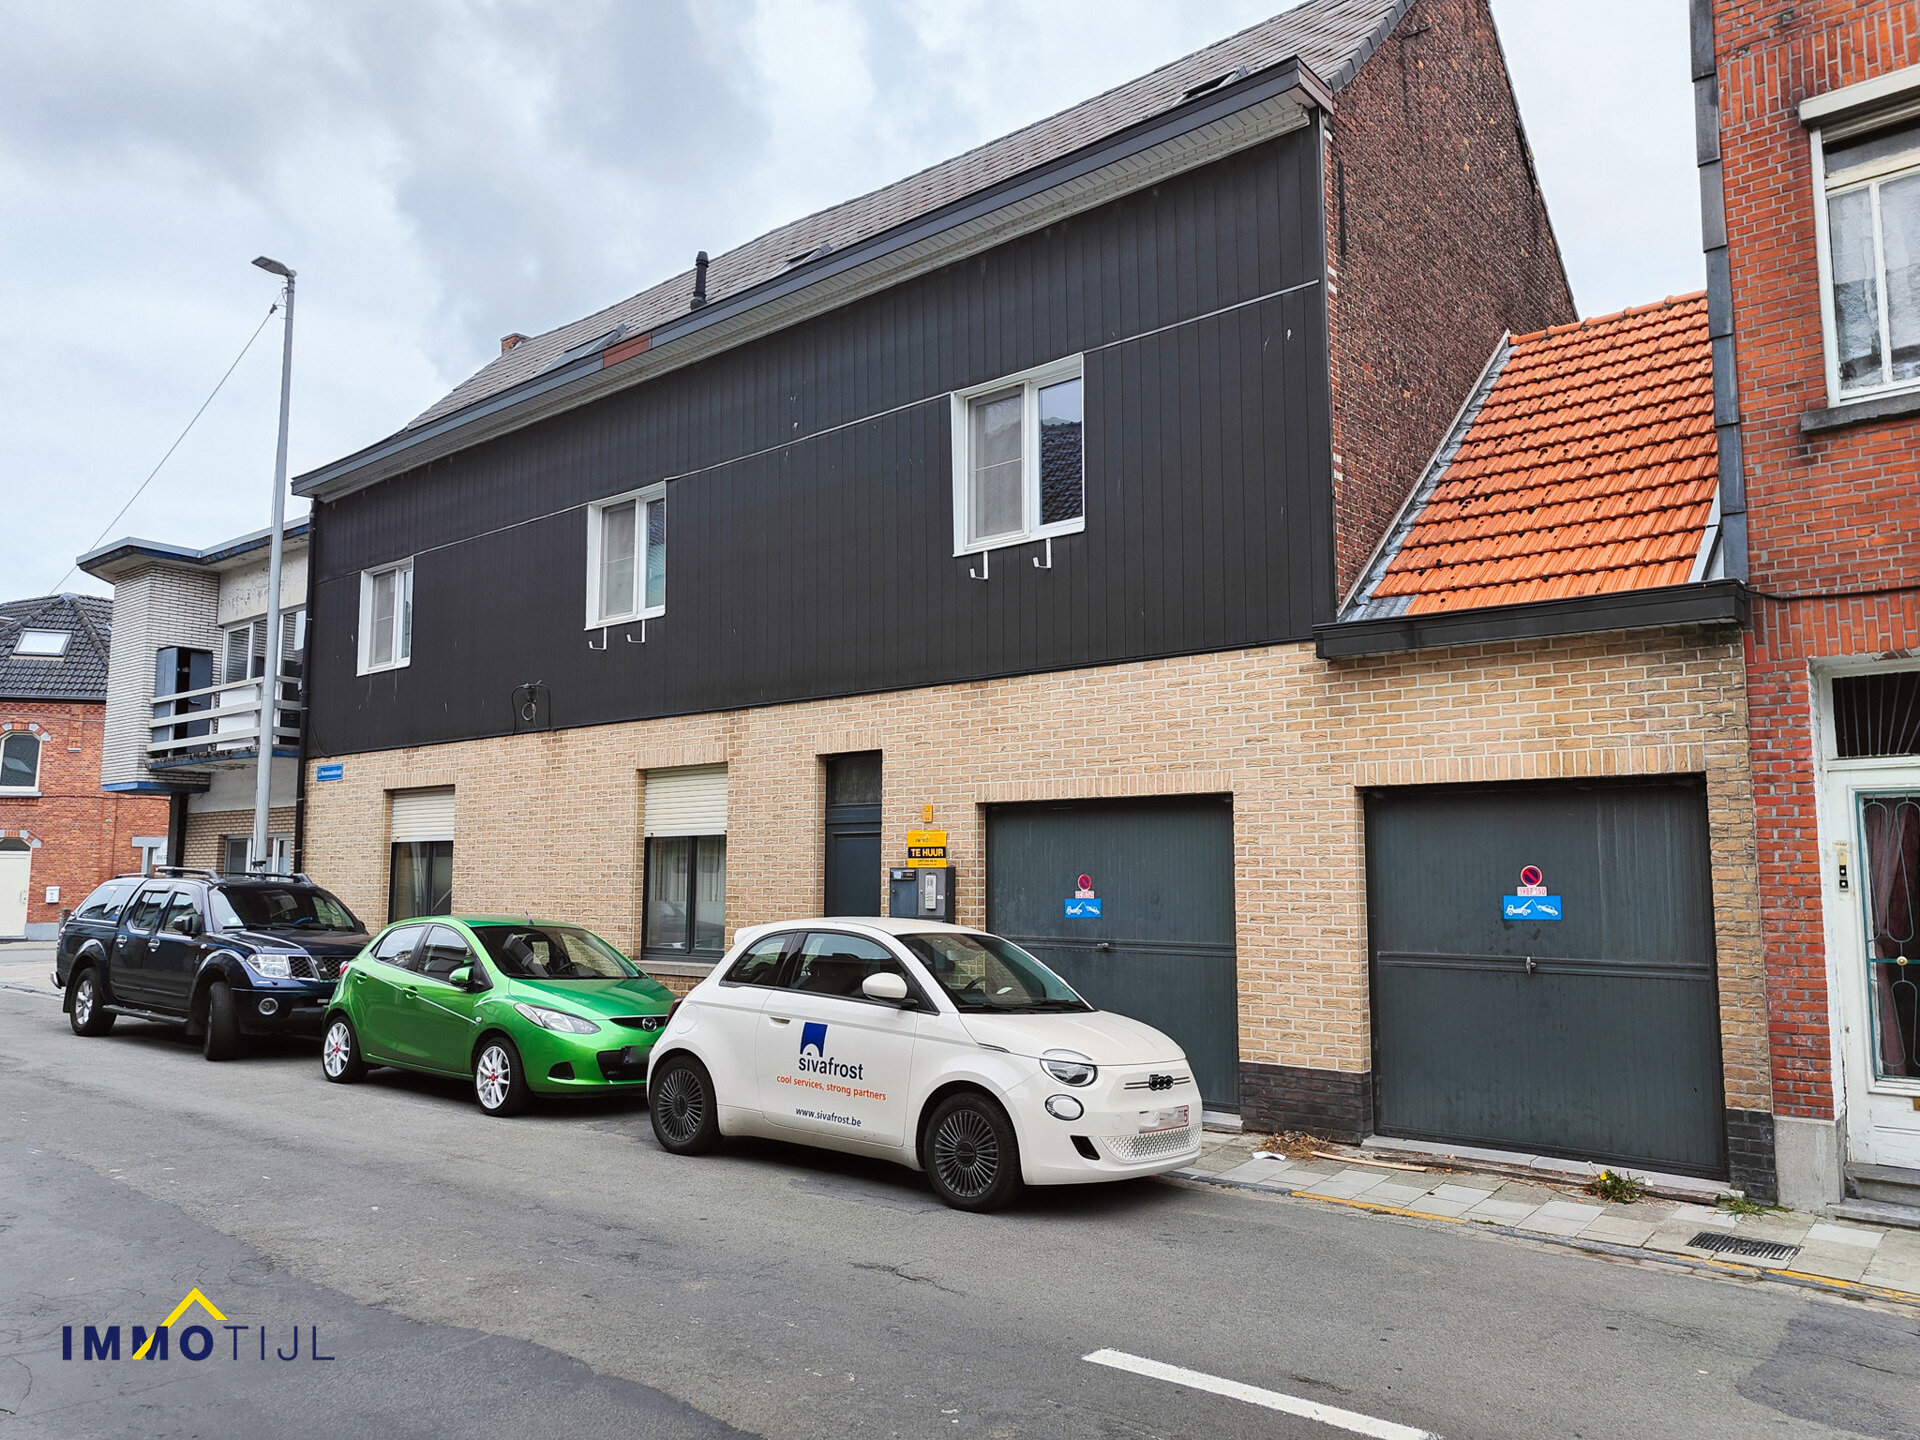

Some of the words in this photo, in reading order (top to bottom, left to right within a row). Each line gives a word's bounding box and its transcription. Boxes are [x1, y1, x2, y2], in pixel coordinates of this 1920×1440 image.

[911, 848, 921, 857] TE
[922, 848, 944, 857] HUUR
[798, 1052, 863, 1080] sivafrost
[776, 1075, 792, 1084] cool
[793, 1078, 825, 1091] services,
[826, 1083, 852, 1097] strong
[853, 1087, 887, 1101] partners
[1149, 1074, 1173, 1091] 500
[795, 1107, 862, 1127] www.sivafrost.be
